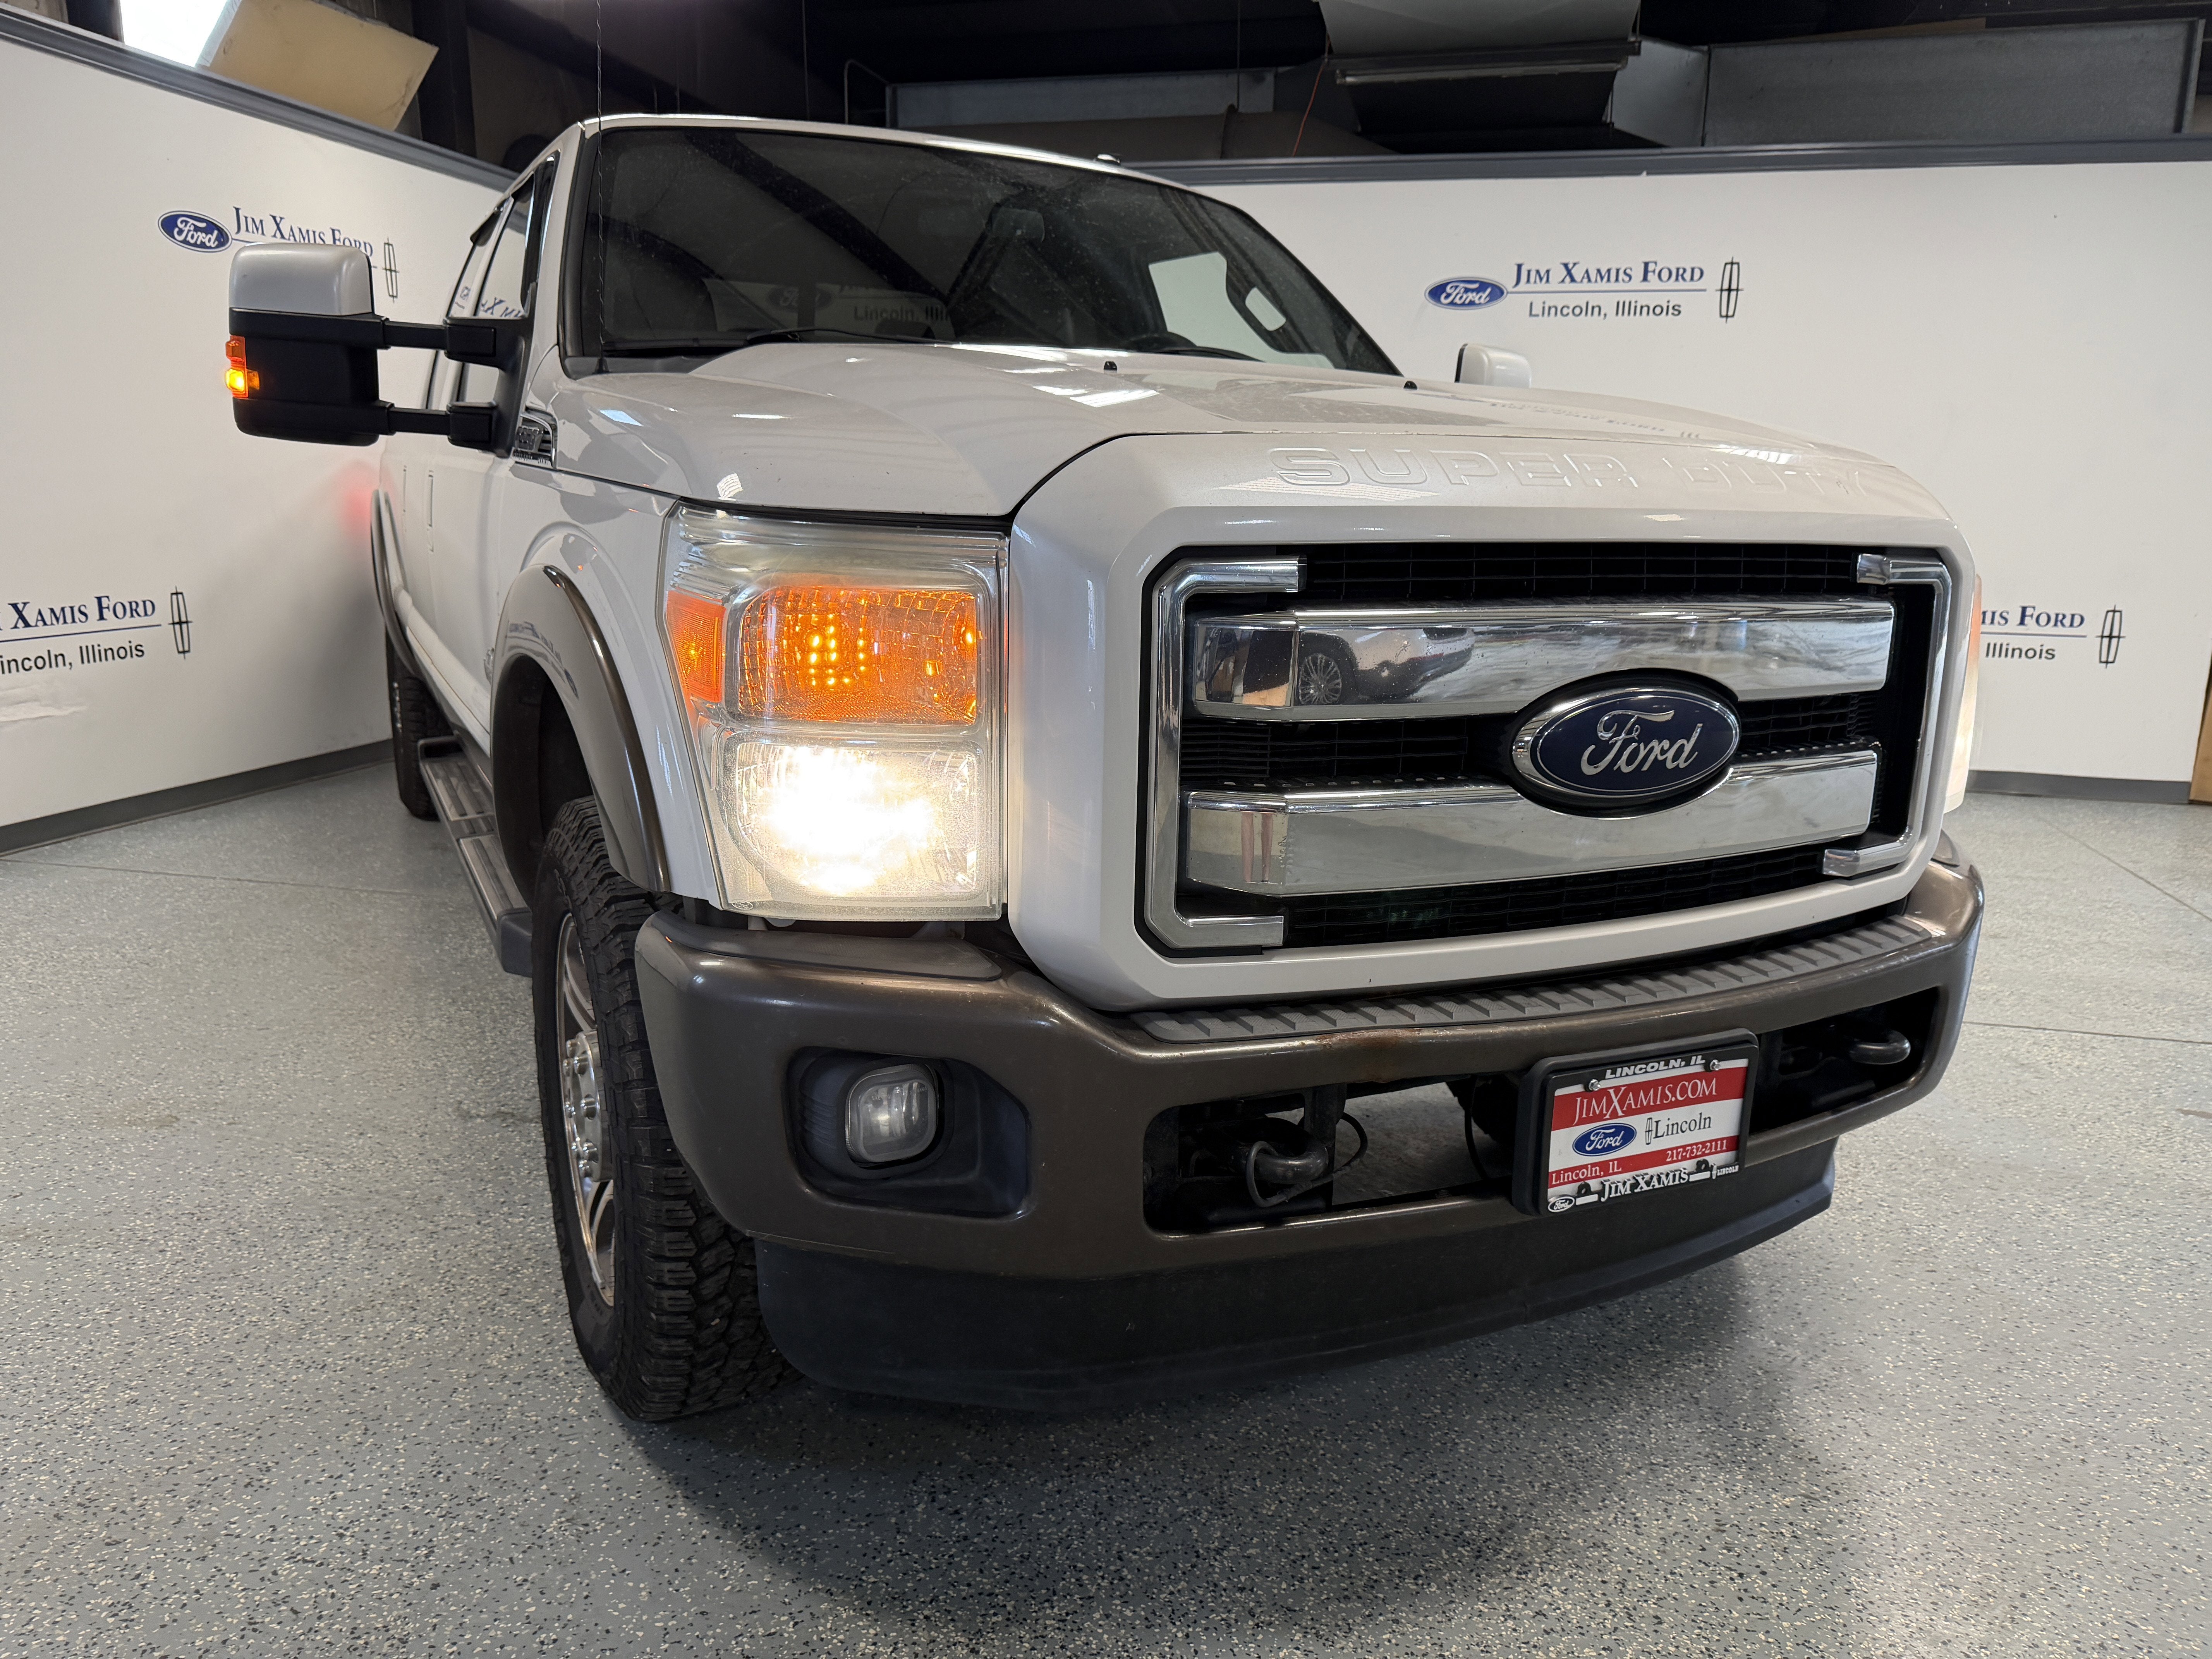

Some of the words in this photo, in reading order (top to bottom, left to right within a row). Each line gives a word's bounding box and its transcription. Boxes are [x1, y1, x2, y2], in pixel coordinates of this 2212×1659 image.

[174, 216, 218, 248] Ford
[233, 206, 266, 236] JIM
[269, 214, 325, 244] XAMIS
[1512, 263, 1551, 288] JIM
[1558, 262, 1633, 284] XAMIS
[1640, 261, 1704, 283] FORD
[1440, 283, 1490, 304] Ford
[1528, 301, 1607, 320] Lincoln,
[1615, 300, 1682, 316] Illinois
[1268, 447, 1638, 488] SUPER
[8, 602, 89, 629] XAMIS
[94, 596, 155, 621] FORD
[2016, 605, 2085, 628] FORD
[0, 650, 72, 674] incoln,
[79, 641, 144, 664] Illinois
[1985, 642, 2056, 660] Illinois
[1581, 710, 1703, 775] Ford
[1605, 1059, 1685, 1079] LINCOLN,
[1690, 1055, 1705, 1066] IL
[1573, 1078, 1717, 1125] JIMXAMIS.COM
[1654, 1112, 1712, 1138] Lincoln
[1586, 1129, 1625, 1151] Ford
[1666, 1140, 1727, 1162] 217-732-2111
[1551, 1166, 1604, 1185] Lincoln,
[1609, 1163, 1621, 1173] IL
[1601, 1180, 1632, 1202] JIM
[1634, 1169, 1689, 1193] XAMIS
[1553, 1199, 1569, 1210] Ford
